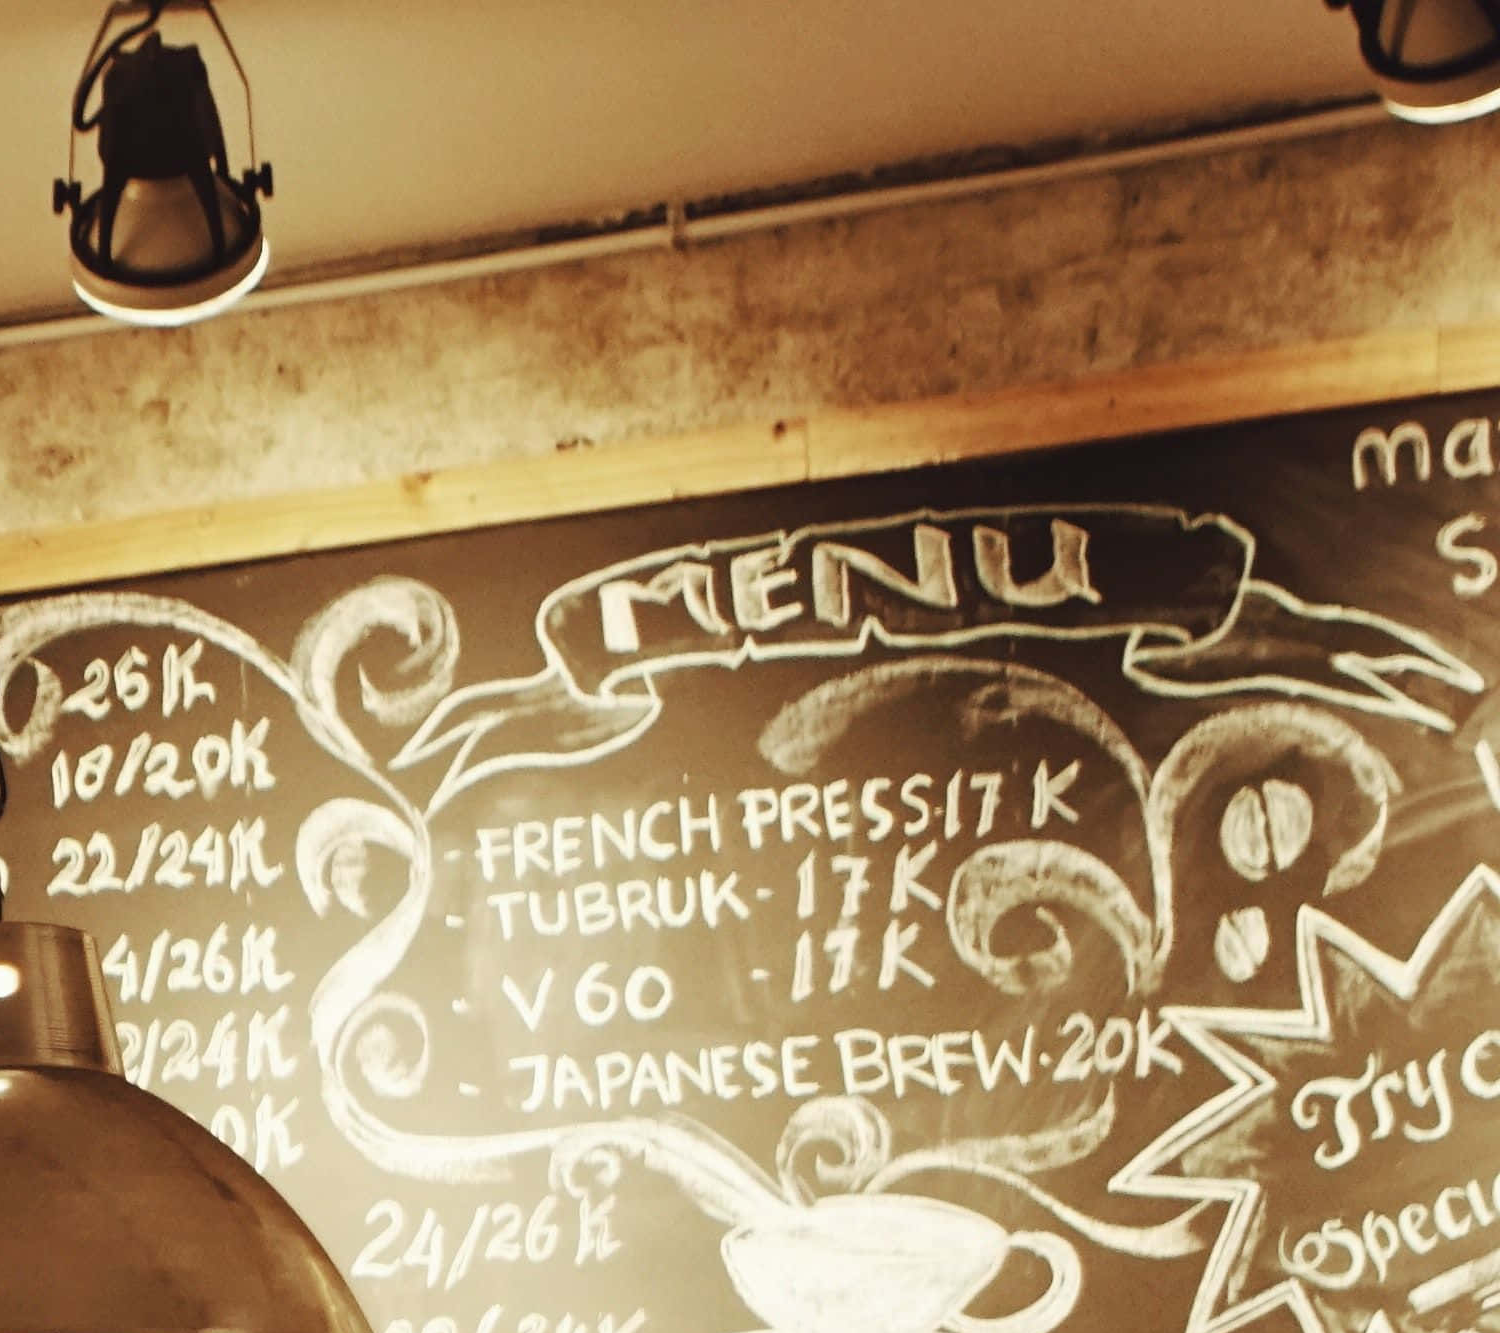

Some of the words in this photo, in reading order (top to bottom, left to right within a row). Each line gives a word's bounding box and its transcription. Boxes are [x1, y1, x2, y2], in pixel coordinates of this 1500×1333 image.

[1352, 416, 1500, 491] ma
[598, 518, 1102, 655] MENU
[46, 816, 285, 897] 22/24K
[475, 792, 721, 881] FRENCH
[101, 922, 296, 1003] 4/26K
[115, 1004, 300, 1089] 2/24K
[508, 1034, 822, 1113] JAPANESE
[834, 1024, 1035, 1098] BREW
[210, 1095, 303, 1173] 0K
[1290, 1048, 1453, 1169] Try
